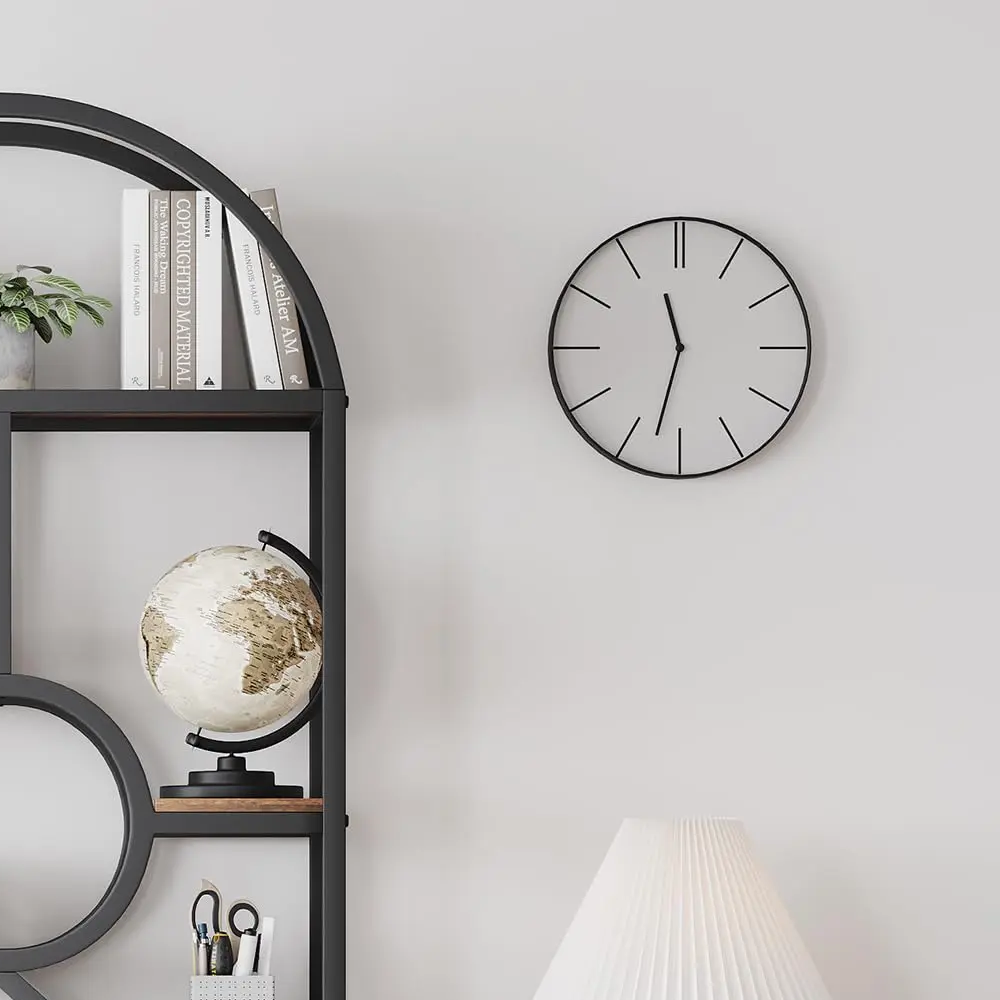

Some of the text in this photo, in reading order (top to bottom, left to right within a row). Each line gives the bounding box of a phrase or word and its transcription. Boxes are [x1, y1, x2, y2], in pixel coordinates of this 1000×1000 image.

[133, 244, 141, 316] FRANCOIS HALARD
[158, 198, 169, 294] The Waking Dream
[242, 244, 260, 316] FRANCOIS HALARD
[176, 198, 191, 385] COPYRIGHTED MATERIAL
[271, 273, 299, 355] Atelier AM
